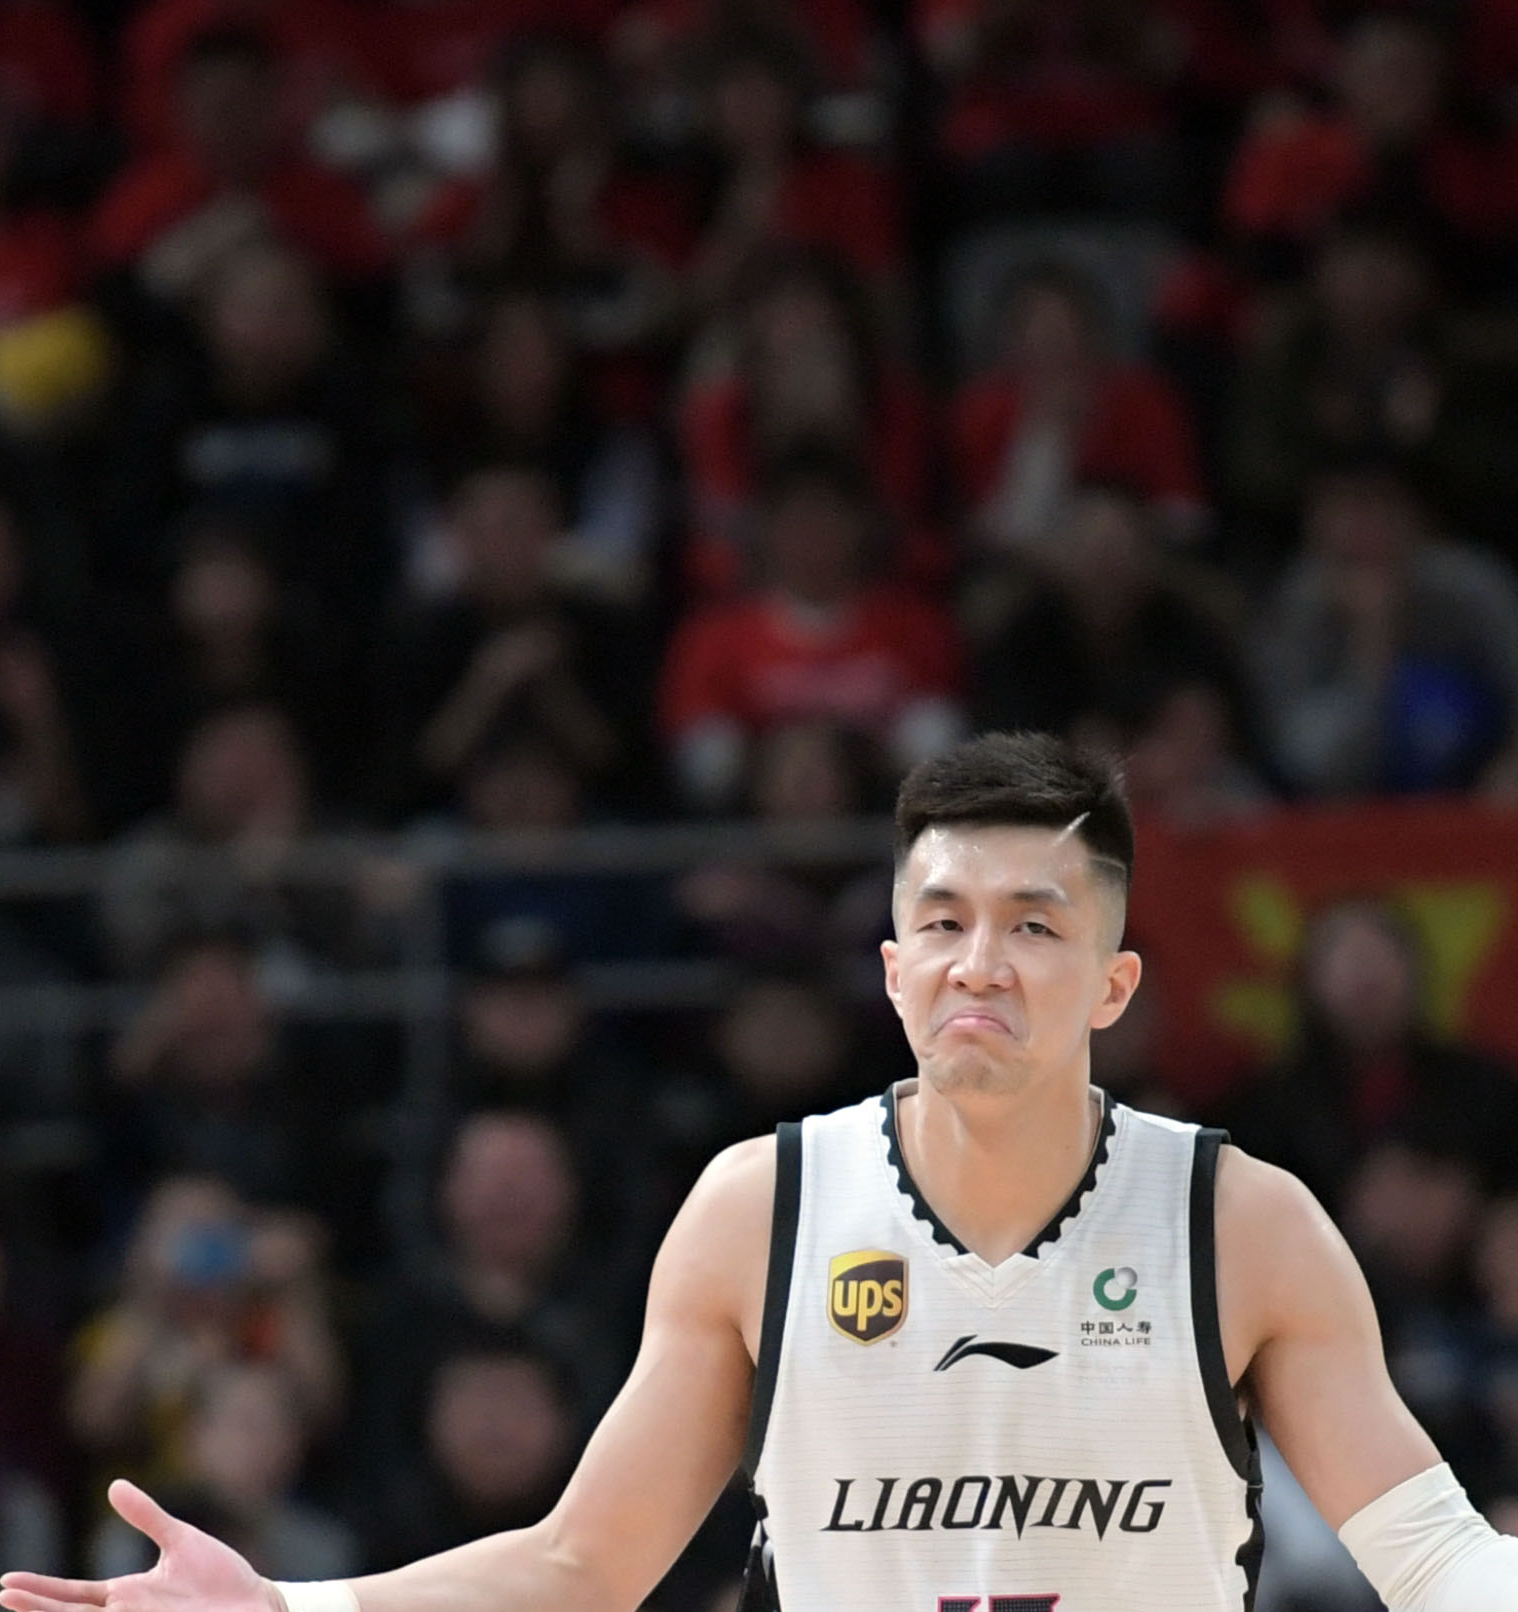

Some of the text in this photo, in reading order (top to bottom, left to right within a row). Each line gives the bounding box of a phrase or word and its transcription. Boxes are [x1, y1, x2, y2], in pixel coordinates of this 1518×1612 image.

[833, 1280, 902, 1331] ups
[1081, 1321, 1152, 1335] 中国人寿
[1081, 1337, 1151, 1346] CHINA LIFE
[819, 1475, 1173, 1541] LIAONING
